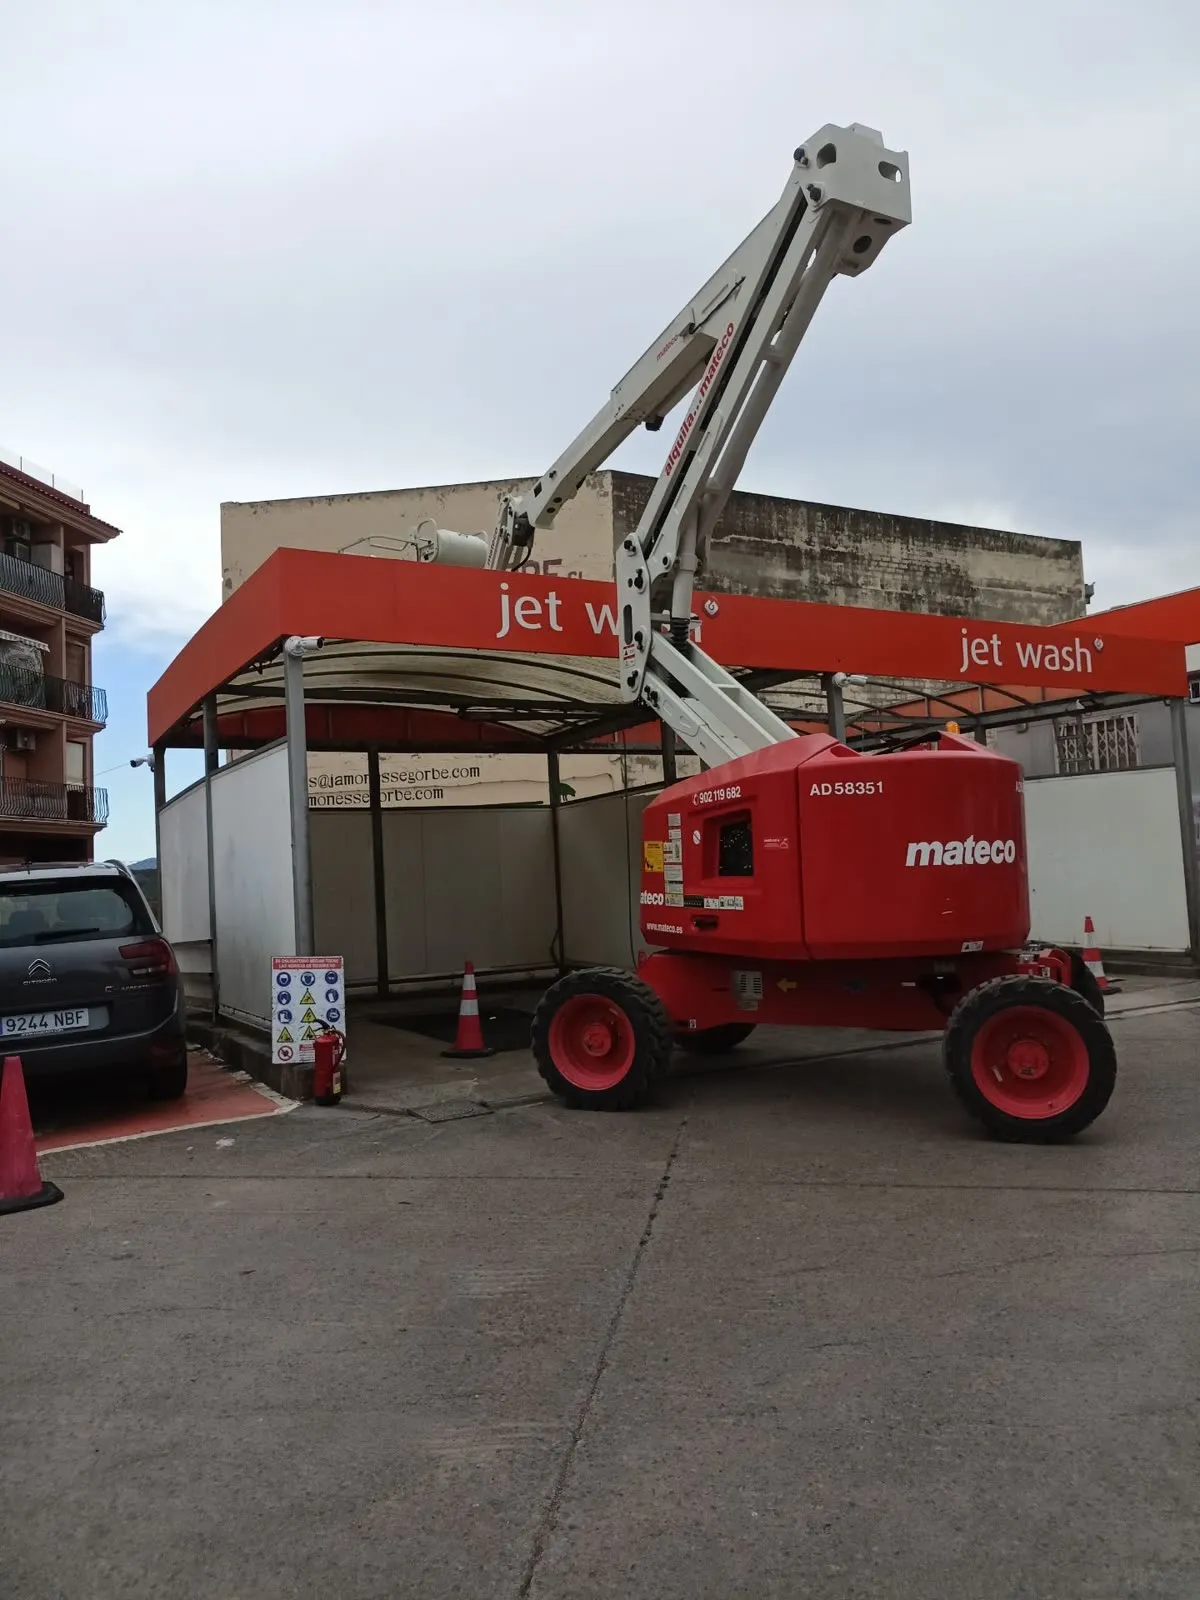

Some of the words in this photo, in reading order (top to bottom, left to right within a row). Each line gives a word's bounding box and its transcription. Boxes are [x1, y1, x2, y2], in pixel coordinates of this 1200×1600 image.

[699, 322, 734, 396] mateco
[496, 582, 563, 639] jet
[960, 628, 1003, 673] jet
[1016, 637, 1092, 673] wash
[309, 766, 480, 788] s@jamonssegorbe.com
[308, 788, 444, 806] monesseorbe.com
[700, 792, 712, 804] 902
[713, 788, 725, 801] 119
[726, 786, 741, 799] 682
[905, 834, 1016, 867] mateco
[640, 890, 664, 905] ateco
[646, 922, 683, 934] www.mateco.es
[6, 1014, 49, 1032] 9244
[54, 1010, 84, 1028] NBF
